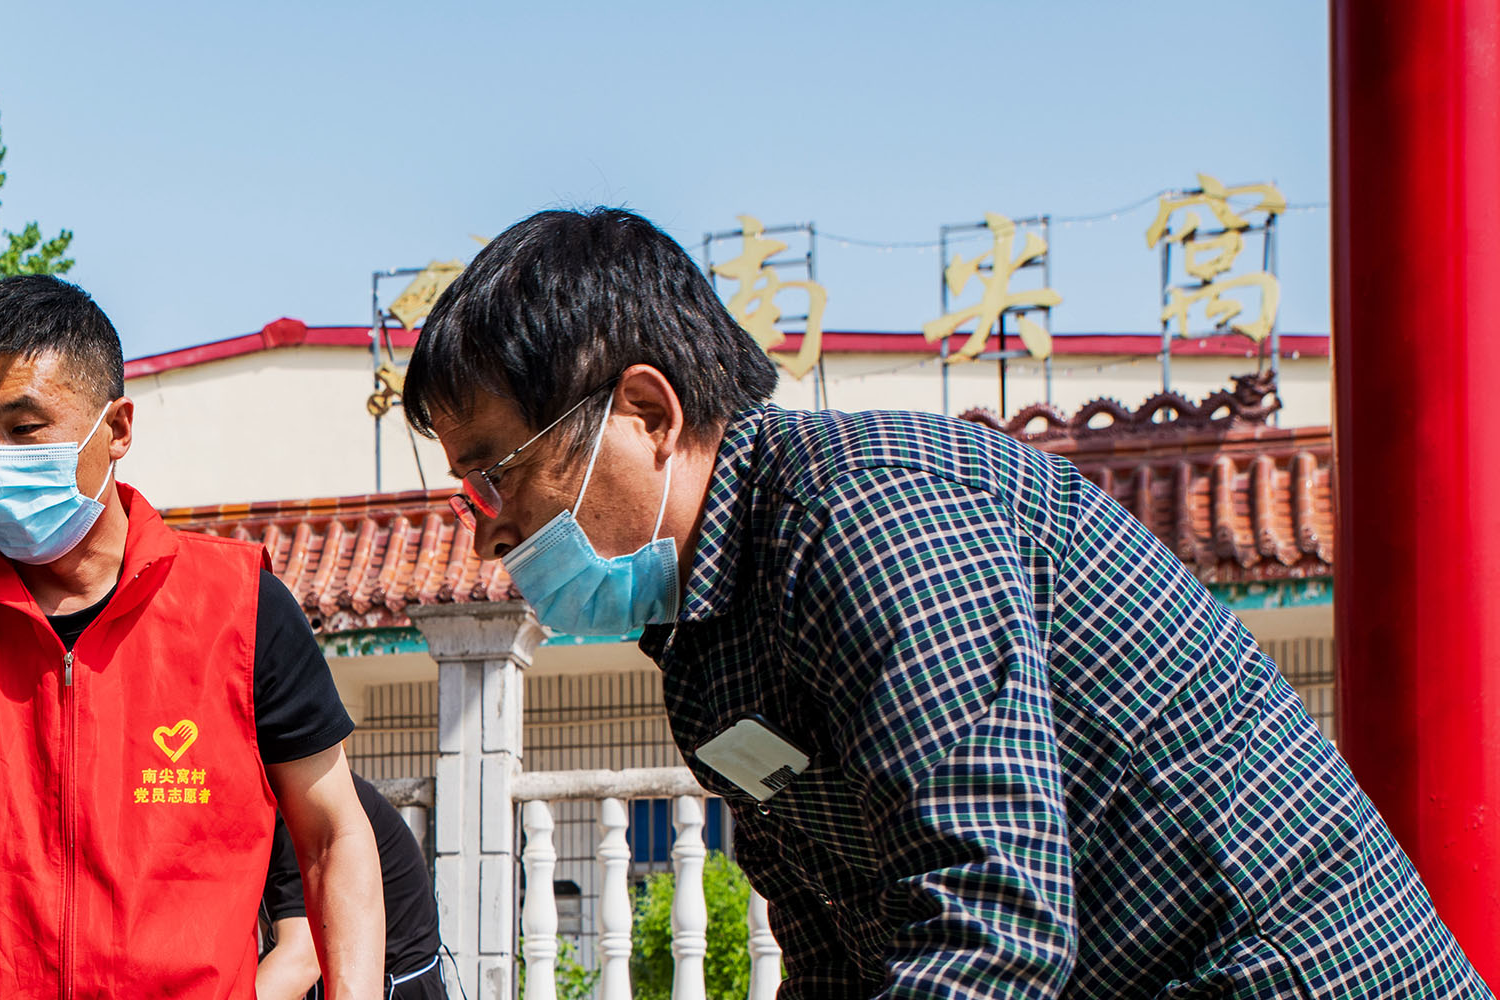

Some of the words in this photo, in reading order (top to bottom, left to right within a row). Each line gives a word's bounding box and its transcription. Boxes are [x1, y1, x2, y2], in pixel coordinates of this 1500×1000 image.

[142, 768, 206, 784] 南尖窝村
[133, 787, 211, 804] 党员志愿者
